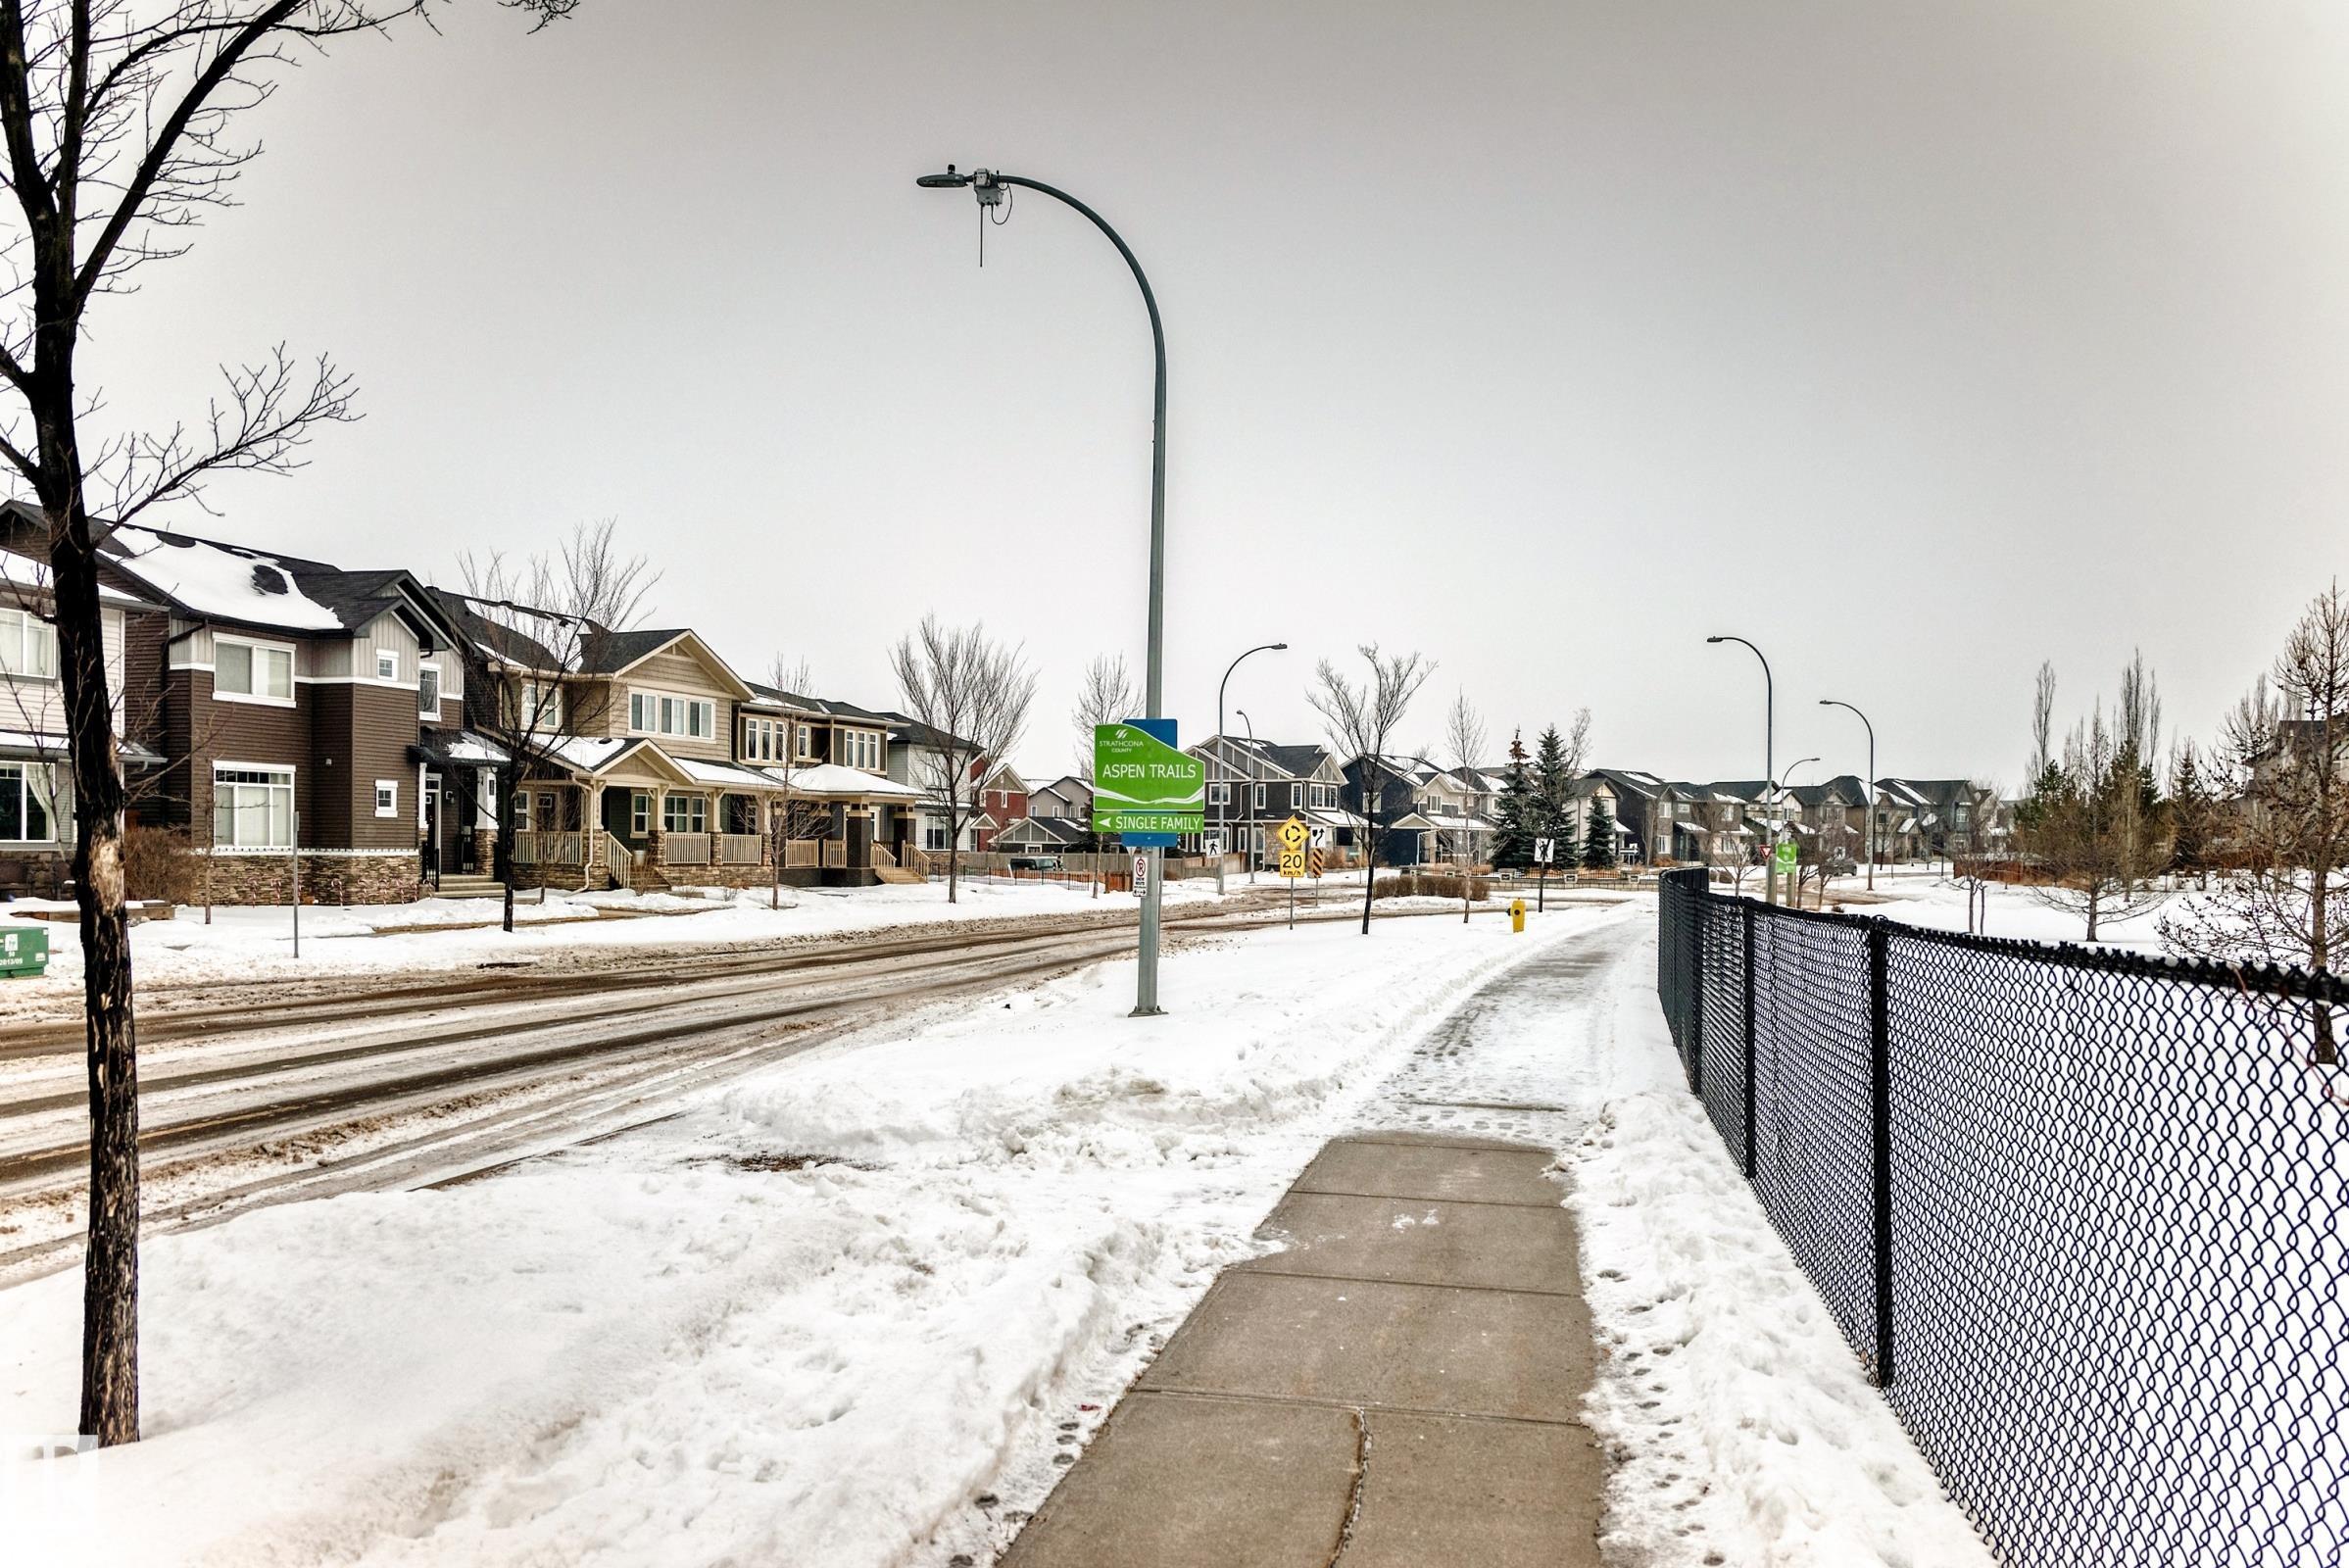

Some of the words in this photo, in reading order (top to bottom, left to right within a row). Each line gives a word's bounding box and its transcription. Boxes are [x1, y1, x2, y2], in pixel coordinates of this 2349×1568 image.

[1102, 763, 1146, 778] ASPEN
[1149, 763, 1197, 778] TRAILS
[1115, 815, 1157, 830] SINGLE
[1160, 816, 1200, 830] FAMILY
[1283, 855, 1301, 868] 20
